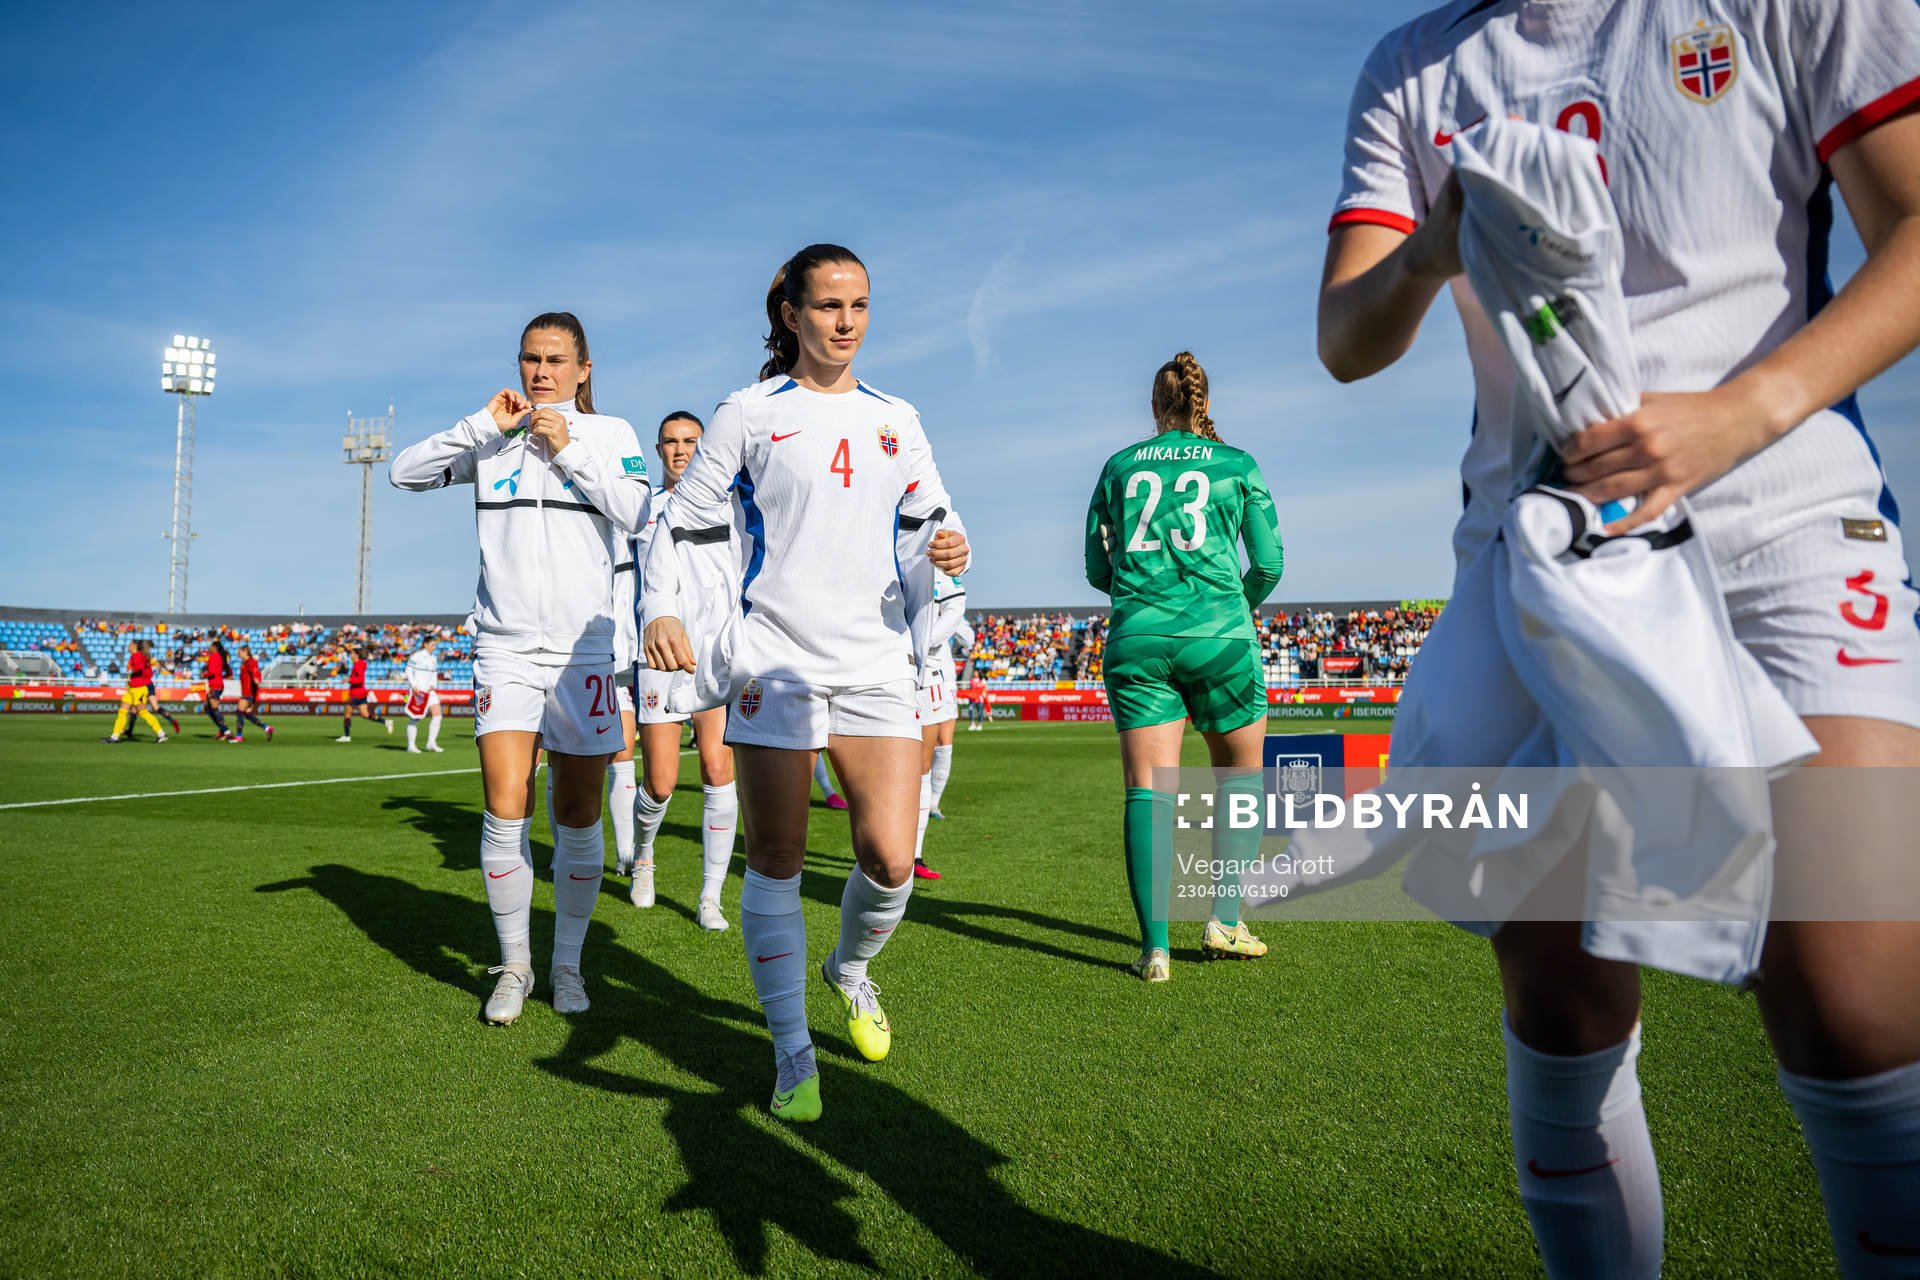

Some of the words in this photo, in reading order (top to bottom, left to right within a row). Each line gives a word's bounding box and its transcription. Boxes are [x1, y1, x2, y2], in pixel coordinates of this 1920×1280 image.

[830, 438, 853, 488] 4
[1133, 446, 1213, 461] MIKALSEN
[1125, 470, 1211, 552] 23
[1839, 570, 1889, 632] 3
[585, 673, 617, 717] 20
[1268, 707, 1323, 717] BERDROLA
[1353, 707, 1398, 717] IBERDRO
